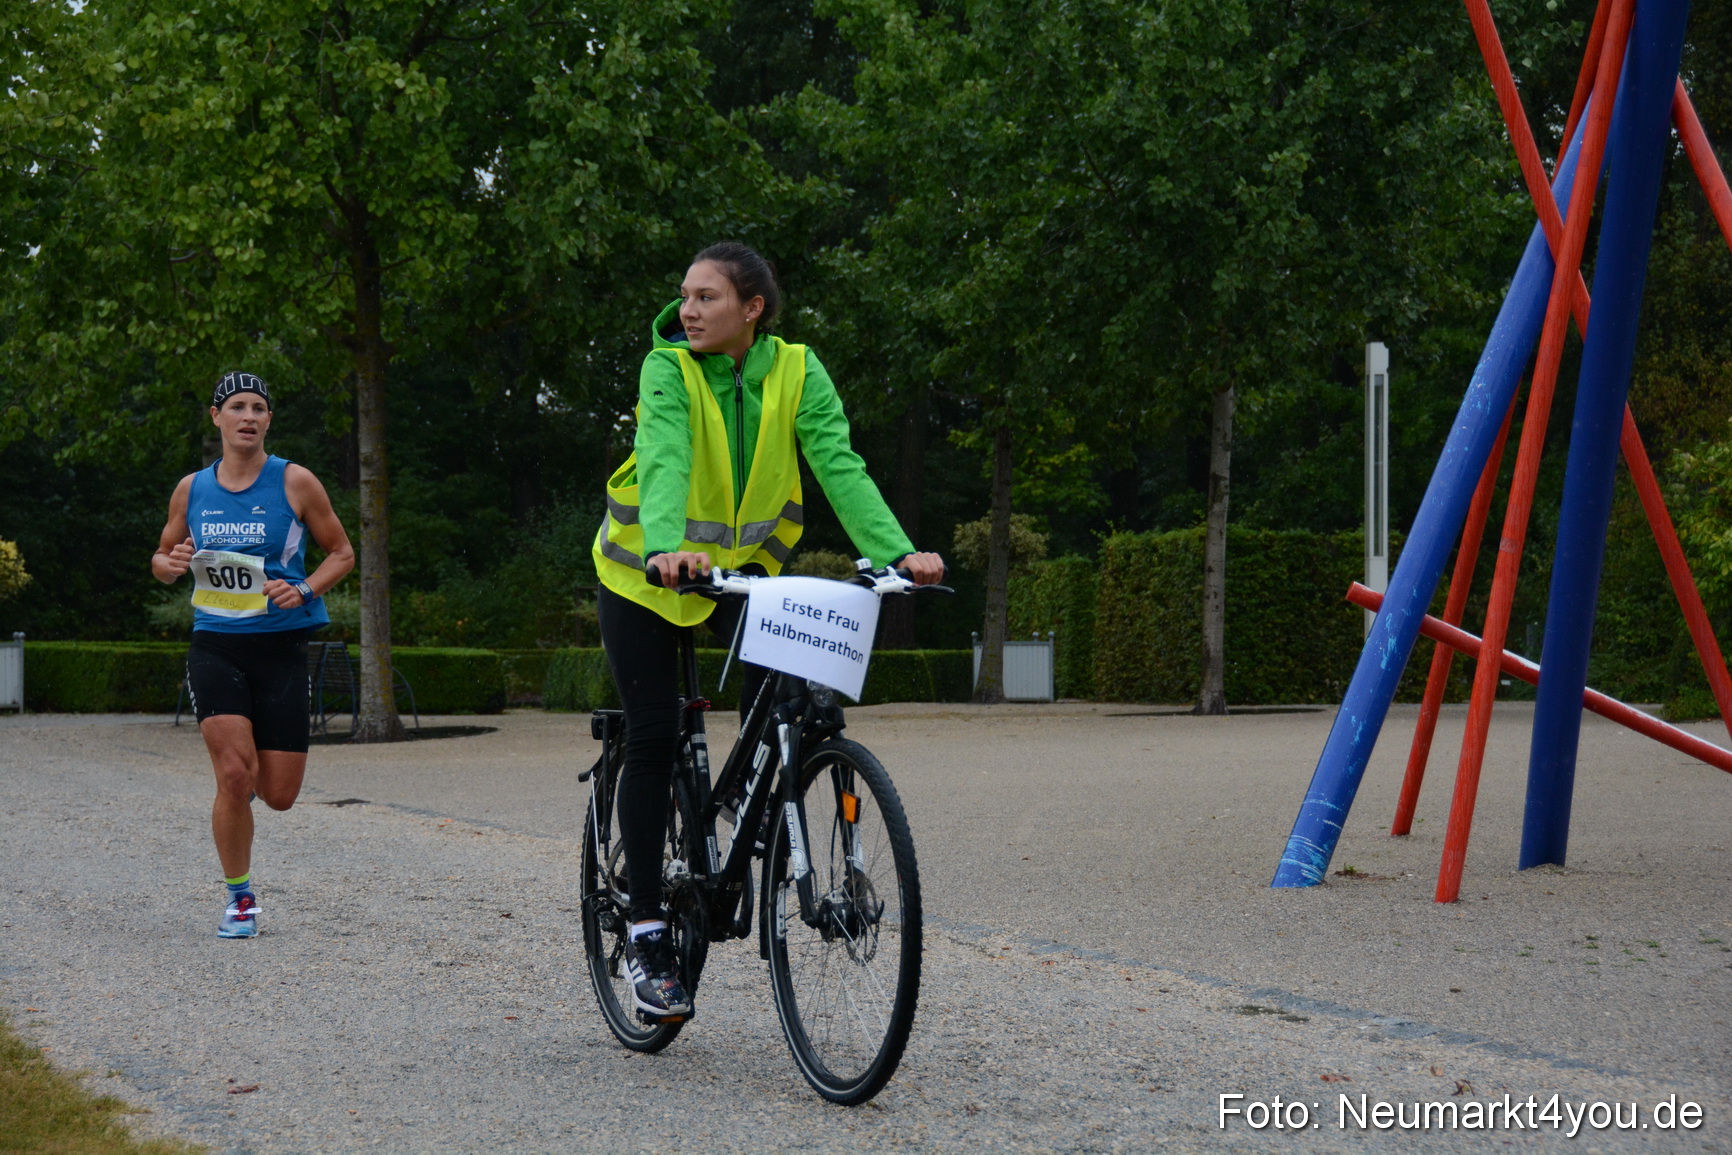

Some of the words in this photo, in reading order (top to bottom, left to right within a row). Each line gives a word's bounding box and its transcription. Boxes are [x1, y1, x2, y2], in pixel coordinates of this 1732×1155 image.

[201, 522, 267, 537] ERDINGER
[206, 566, 252, 590] 606
[782, 597, 822, 620] Erste
[827, 609, 860, 632] Frau
[760, 618, 864, 664] Halbmarathon
[786, 814, 796, 848] SUNTOUR
